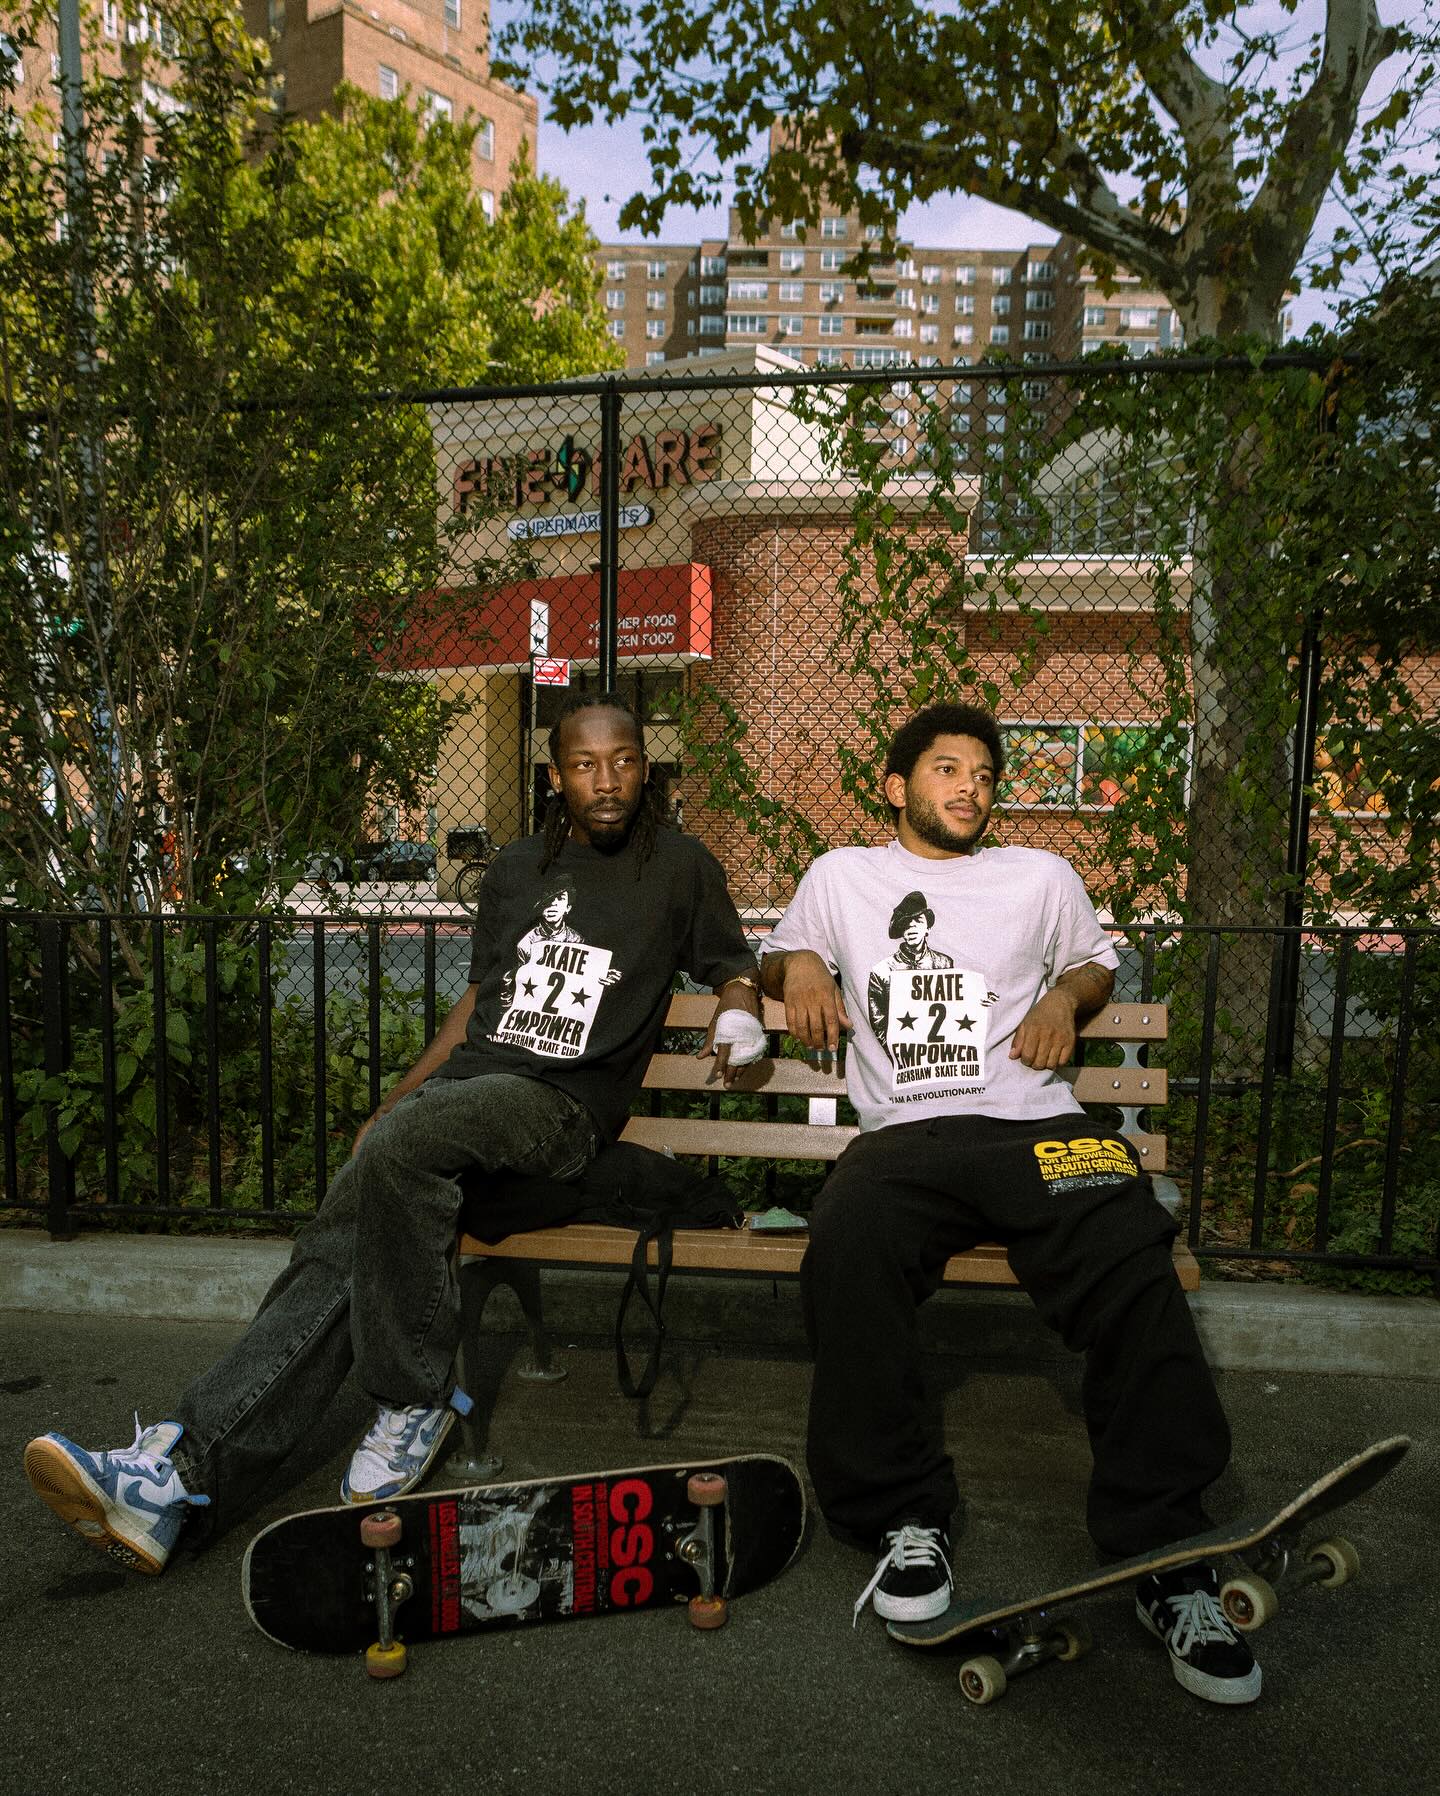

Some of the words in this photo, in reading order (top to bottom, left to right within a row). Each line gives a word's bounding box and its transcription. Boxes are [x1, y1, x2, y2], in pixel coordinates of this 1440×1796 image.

[516, 508, 640, 536] SUPERMARTS
[644, 614, 677, 628] FOOD
[595, 634, 639, 649] FZEN
[642, 632, 675, 645] FOOD
[536, 944, 589, 976] SKATE
[541, 971, 566, 1014] 2
[911, 974, 964, 1001] SKATE
[503, 1009, 586, 1047] EMPOWER
[927, 1002, 947, 1043] 2
[537, 1039, 561, 1055] SKATE
[561, 1045, 580, 1057] CLUB
[892, 1043, 979, 1070] EMPOWER
[896, 1067, 932, 1085] CRENSHAW
[935, 1065, 958, 1078] SKATE
[960, 1064, 980, 1077] CLUB
[895, 1095, 905, 1104] AM
[906, 1094, 912, 1102] A
[1038, 1157, 1060, 1165] FOR
[1040, 1164, 1054, 1175] IN
[1054, 1161, 1091, 1173] SOUTH
[1042, 1173, 1061, 1181] OUR
[1063, 1169, 1095, 1177] PEOPLE
[572, 1484, 593, 1502] IN
[573, 1502, 595, 1549] SOUTH
[609, 1478, 654, 1607] CSC
